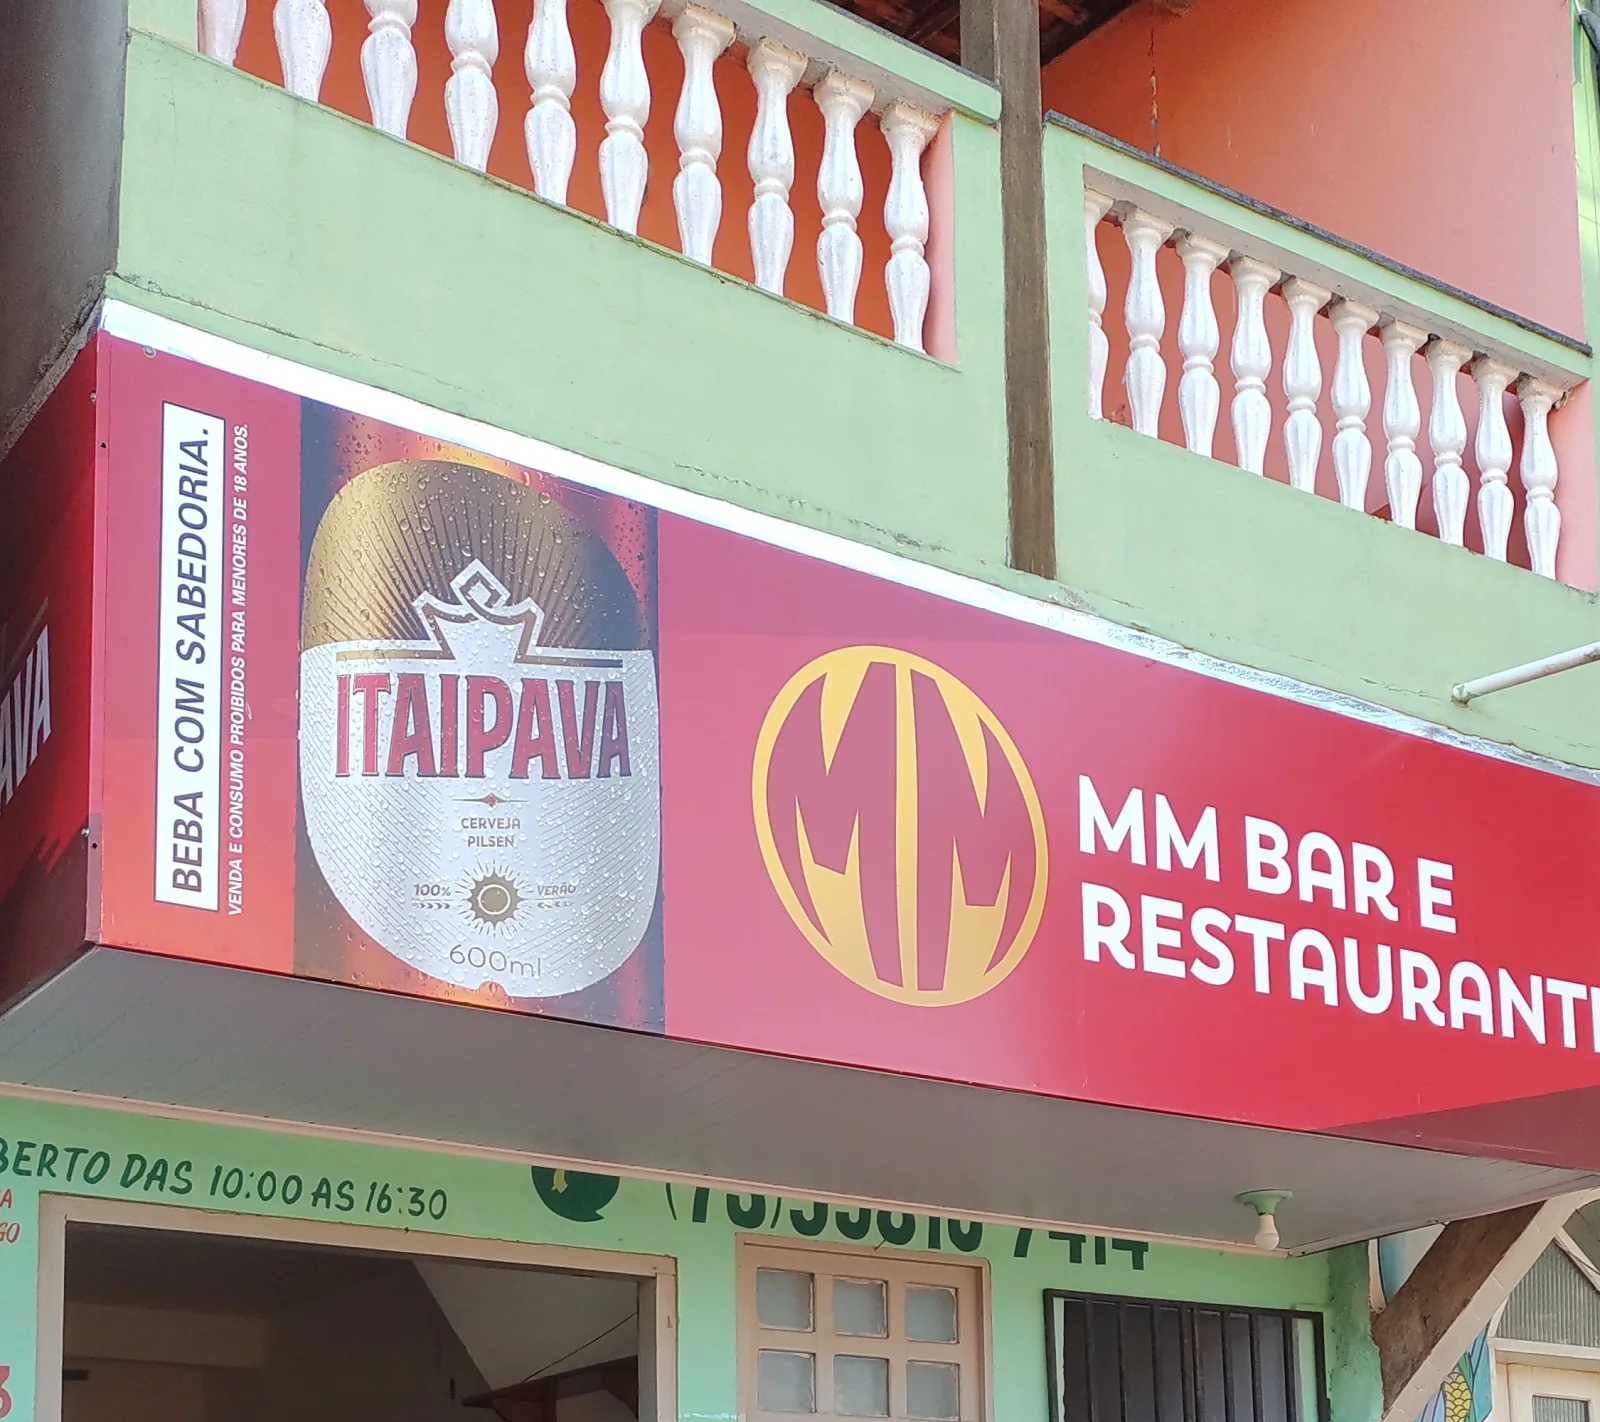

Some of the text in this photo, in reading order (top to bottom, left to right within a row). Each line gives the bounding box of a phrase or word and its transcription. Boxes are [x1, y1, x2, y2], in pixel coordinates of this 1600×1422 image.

[172, 428, 209, 893] BEBA COM SABEDORIA.
[228, 423, 249, 916] VENDA E CONSUMO PROIBIDOS PARA MENORES DE 18 ANOS.
[335, 673, 633, 779] ITAIPAVA
[461, 817, 521, 830] CERVEJA
[467, 835, 515, 848] PILSEN
[1078, 774, 1457, 934] MM BAR E
[413, 884, 452, 897] 100%
[537, 882, 577, 896] VERÃO
[450, 944, 542, 977] 600ml
[119, 1153, 193, 1194] DAS
[209, 1165, 303, 1204] 10:00
[311, 1177, 355, 1211] AS
[365, 1181, 447, 1220] 16:30
